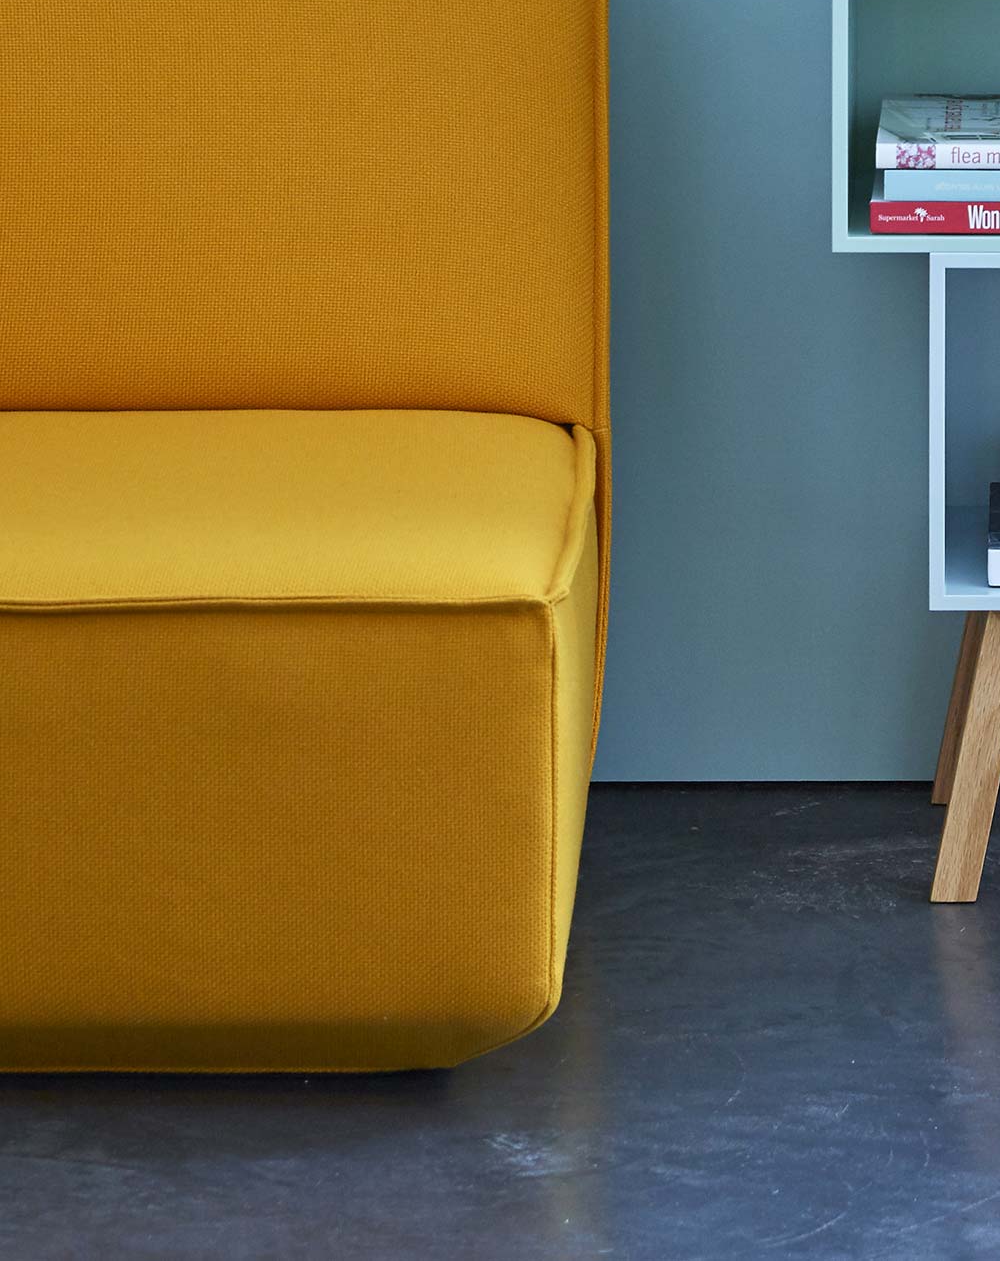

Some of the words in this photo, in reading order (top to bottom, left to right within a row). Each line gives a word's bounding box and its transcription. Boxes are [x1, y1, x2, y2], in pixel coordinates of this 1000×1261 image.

[951, 148, 981, 164] flea
[878, 214, 919, 223] Supermarket
[926, 214, 945, 223] Sarah
